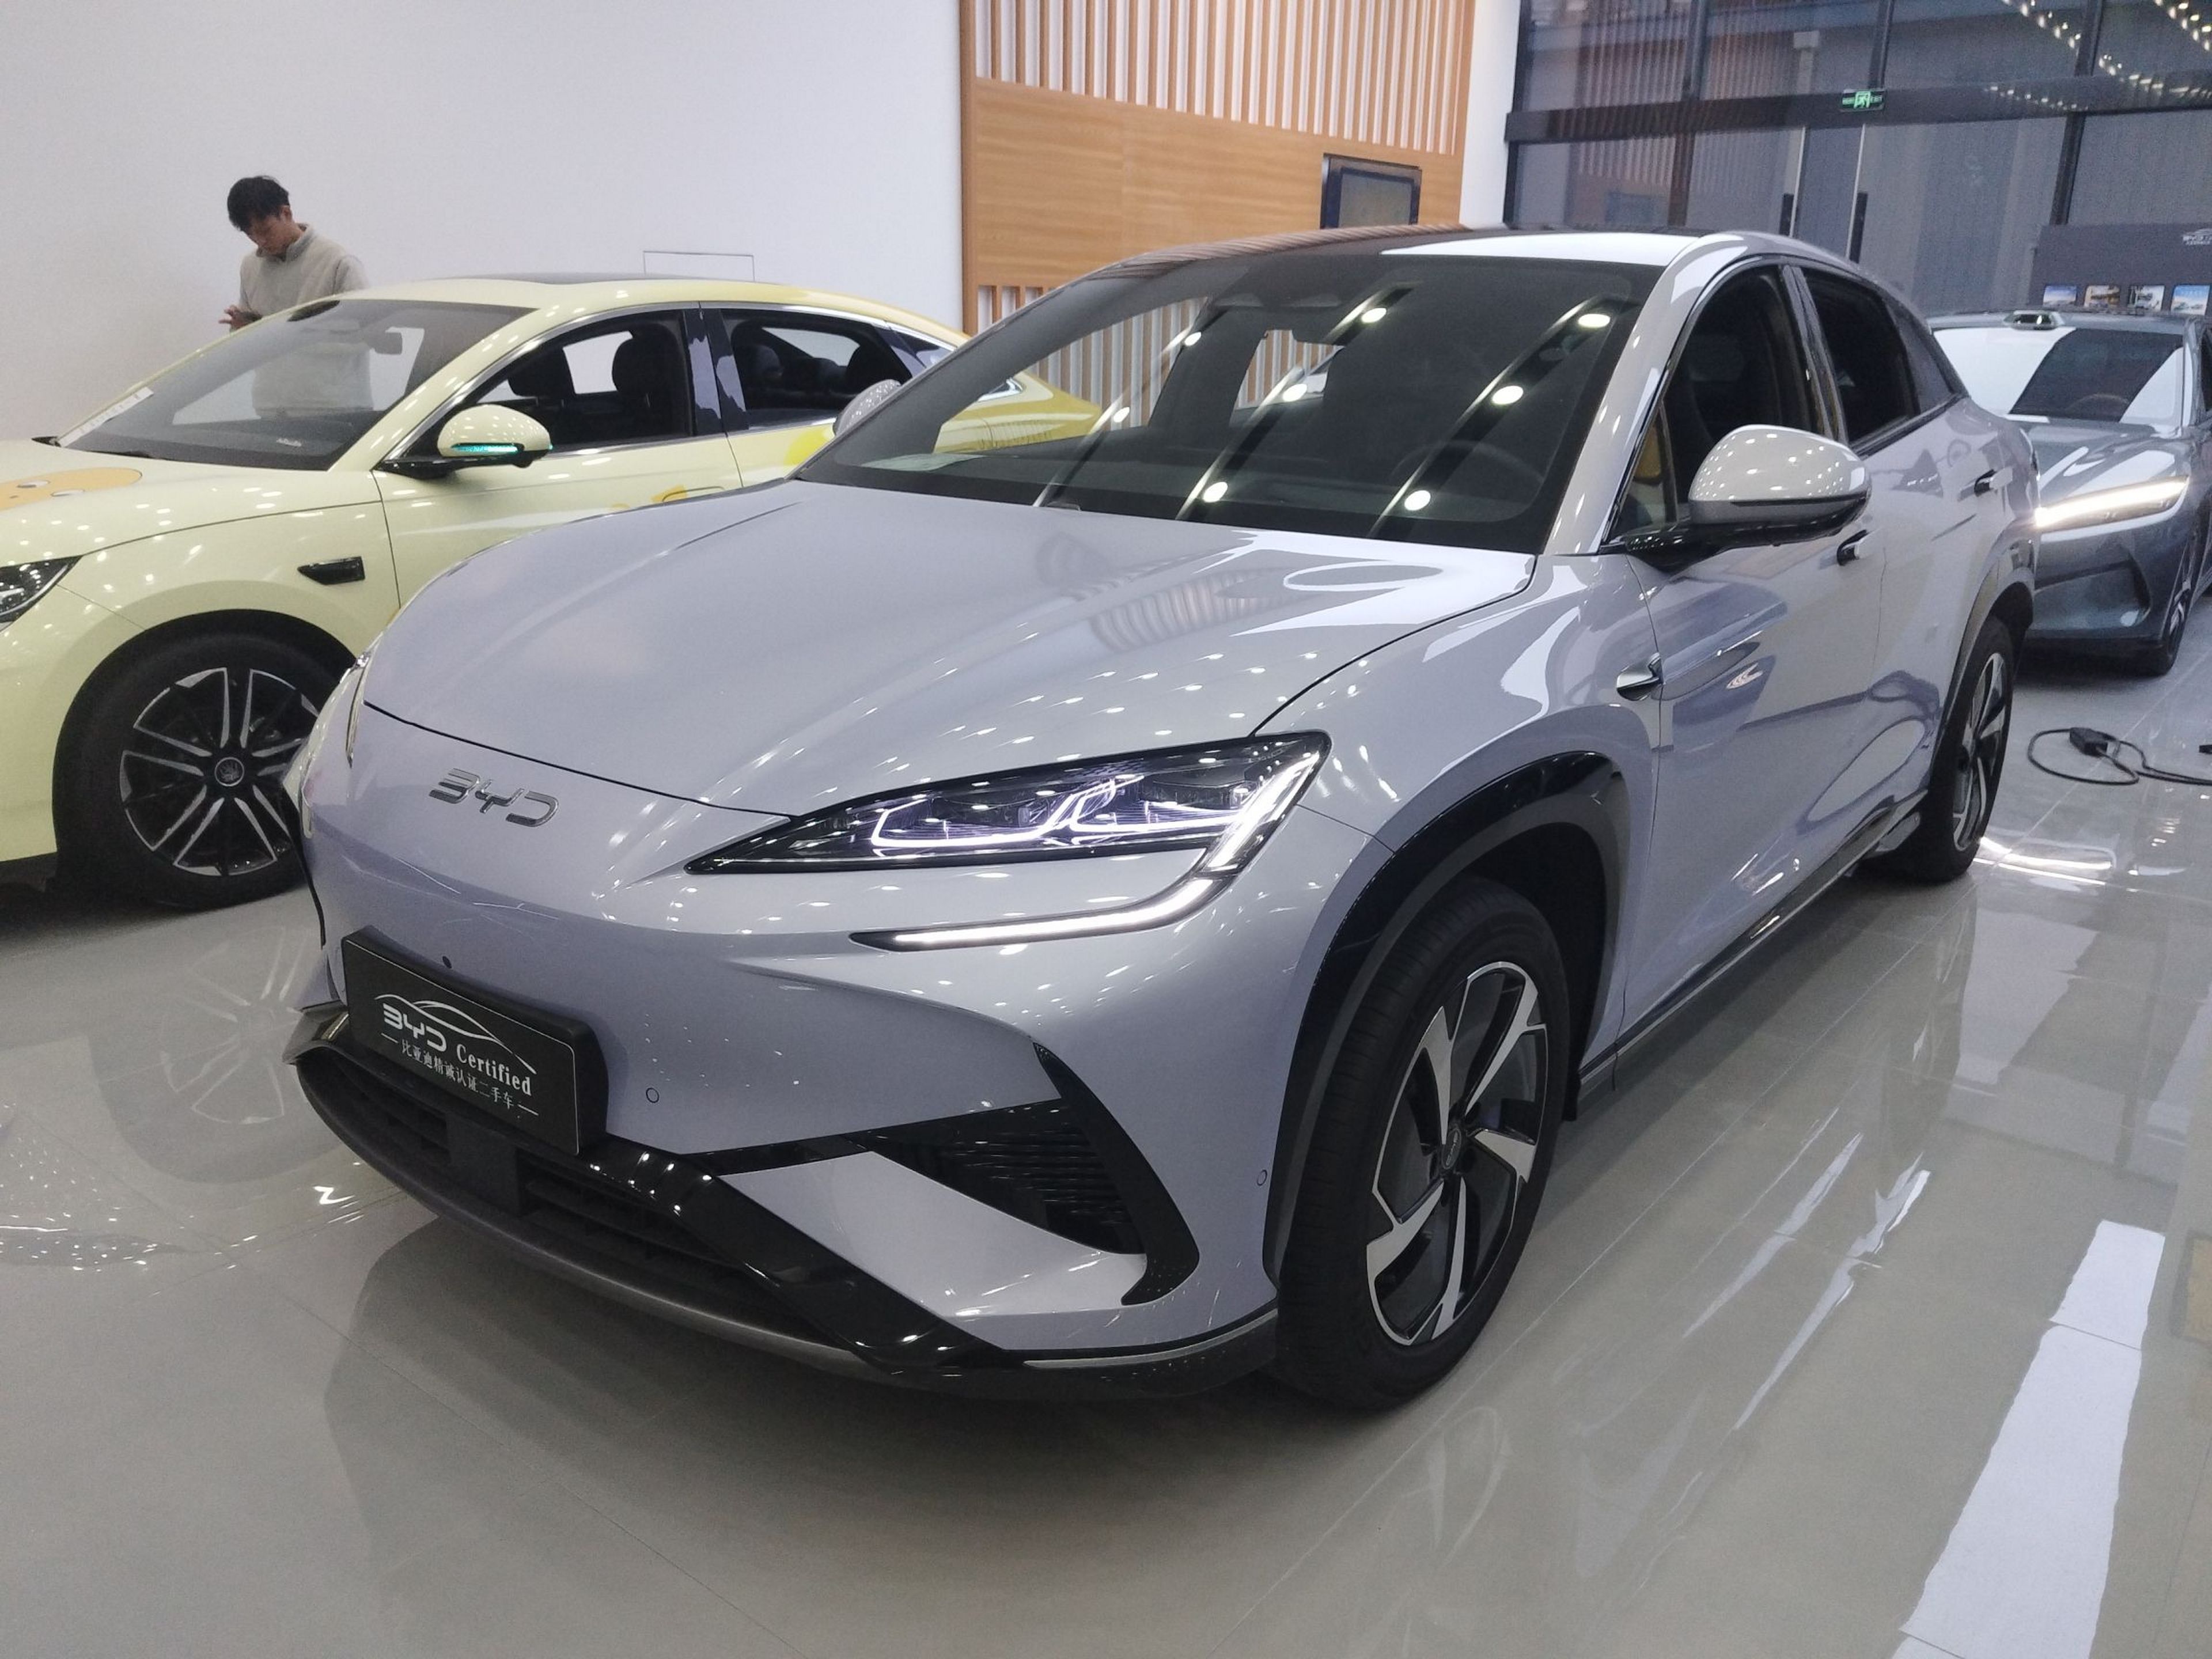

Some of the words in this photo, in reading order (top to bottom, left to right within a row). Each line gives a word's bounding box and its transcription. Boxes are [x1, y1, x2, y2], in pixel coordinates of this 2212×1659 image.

[429, 767, 559, 827] BYD
[382, 1003, 447, 1052] BYD
[456, 1044, 532, 1096] Certified
[402, 1039, 514, 1109] 比亚迪精诚认证二手车
